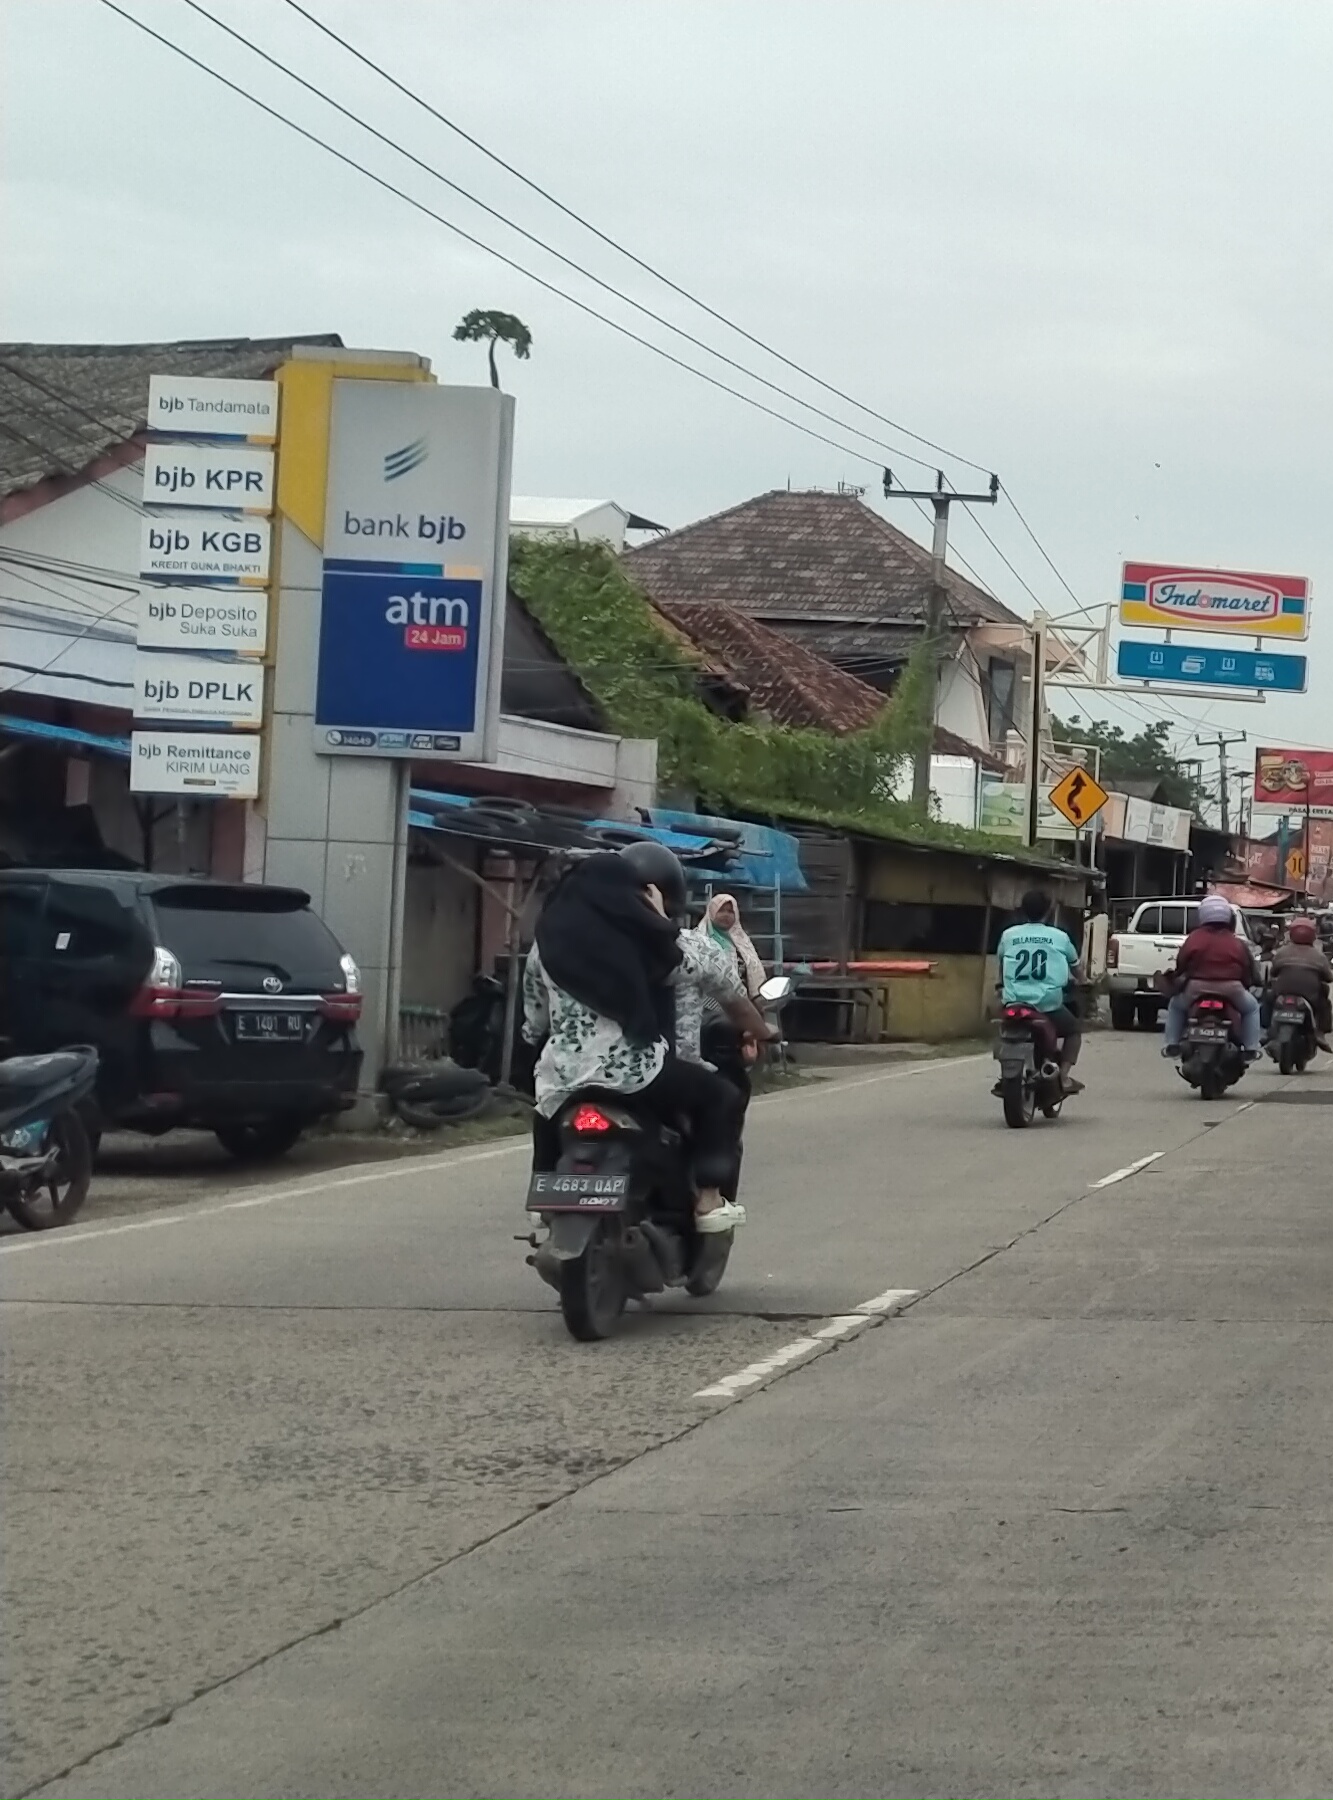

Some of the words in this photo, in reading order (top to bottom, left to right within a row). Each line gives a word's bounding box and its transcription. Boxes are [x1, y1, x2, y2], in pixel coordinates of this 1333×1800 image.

[159, 397, 184, 413] bjb
[187, 398, 270, 415] Tandamata
[155, 465, 196, 492] bjb
[206, 469, 264, 492] KPR
[344, 510, 410, 538] bank
[417, 514, 466, 544] bjb
[149, 528, 190, 555] bjb
[201, 531, 262, 553] KGB
[151, 560, 189, 570] KREDIT
[190, 561, 221, 572] GUNA
[222, 563, 261, 573] BHAKTI
[1154, 584, 1272, 613] Indomaret
[149, 603, 177, 621] bjb
[181, 603, 258, 622] Deposito
[385, 591, 469, 627] atm
[180, 622, 216, 636] Suka
[221, 624, 258, 638] Suka
[411, 630, 428, 643] 24
[431, 631, 462, 645] Jam
[144, 680, 180, 703] bjb
[188, 681, 254, 702] DPLK
[138, 744, 162, 759] bjb
[167, 745, 252, 760] Remittance
[166, 761, 205, 774] KIRIM
[210, 763, 251, 776] UANG
[1015, 949, 1048, 981] 20
[238, 1016, 247, 1030] E
[536, 1178, 547, 1192] E
[552, 1178, 589, 1193] 4683
